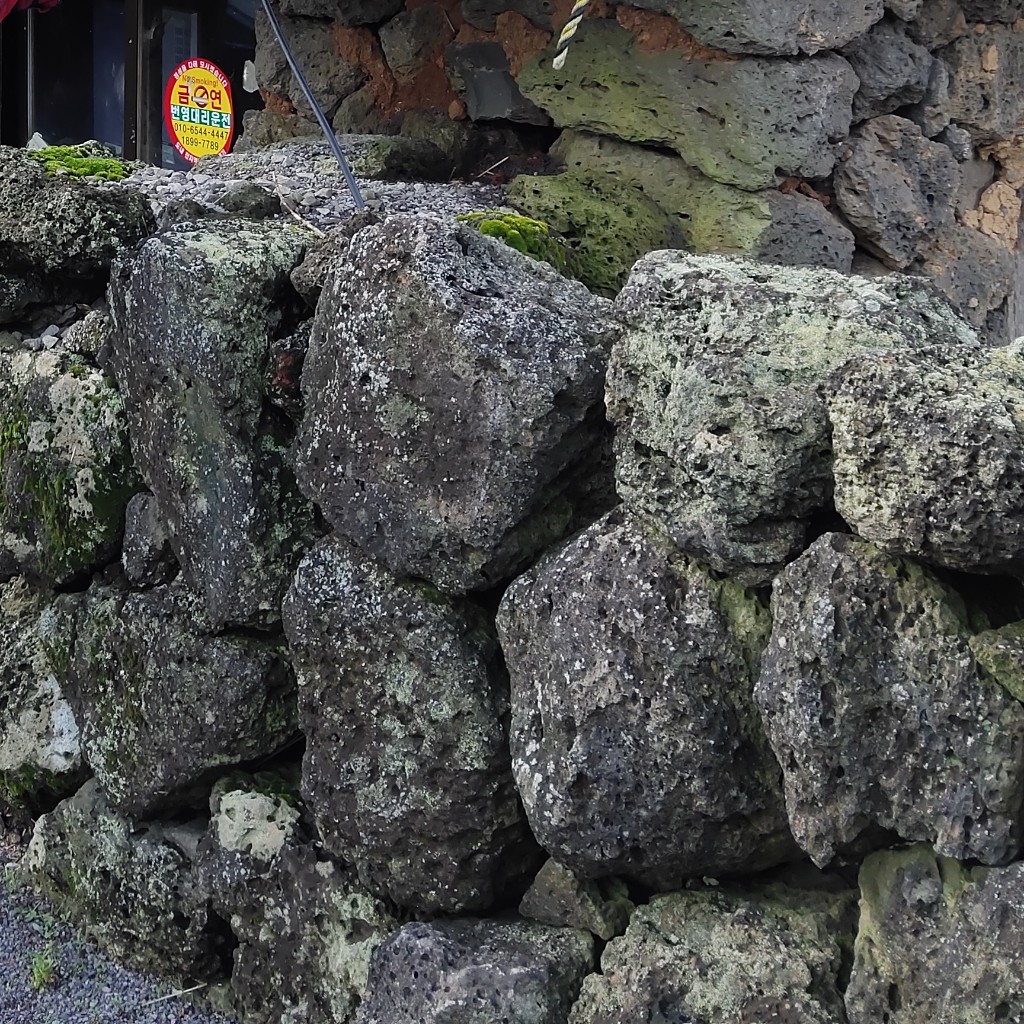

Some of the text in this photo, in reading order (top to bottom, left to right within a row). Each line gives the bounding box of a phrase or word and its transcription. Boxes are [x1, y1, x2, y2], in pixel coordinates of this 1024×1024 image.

[170, 104, 231, 128] 번영대리운전
[174, 122, 229, 141] 010-6544-4447
[181, 136, 219, 151] 1899-7789
